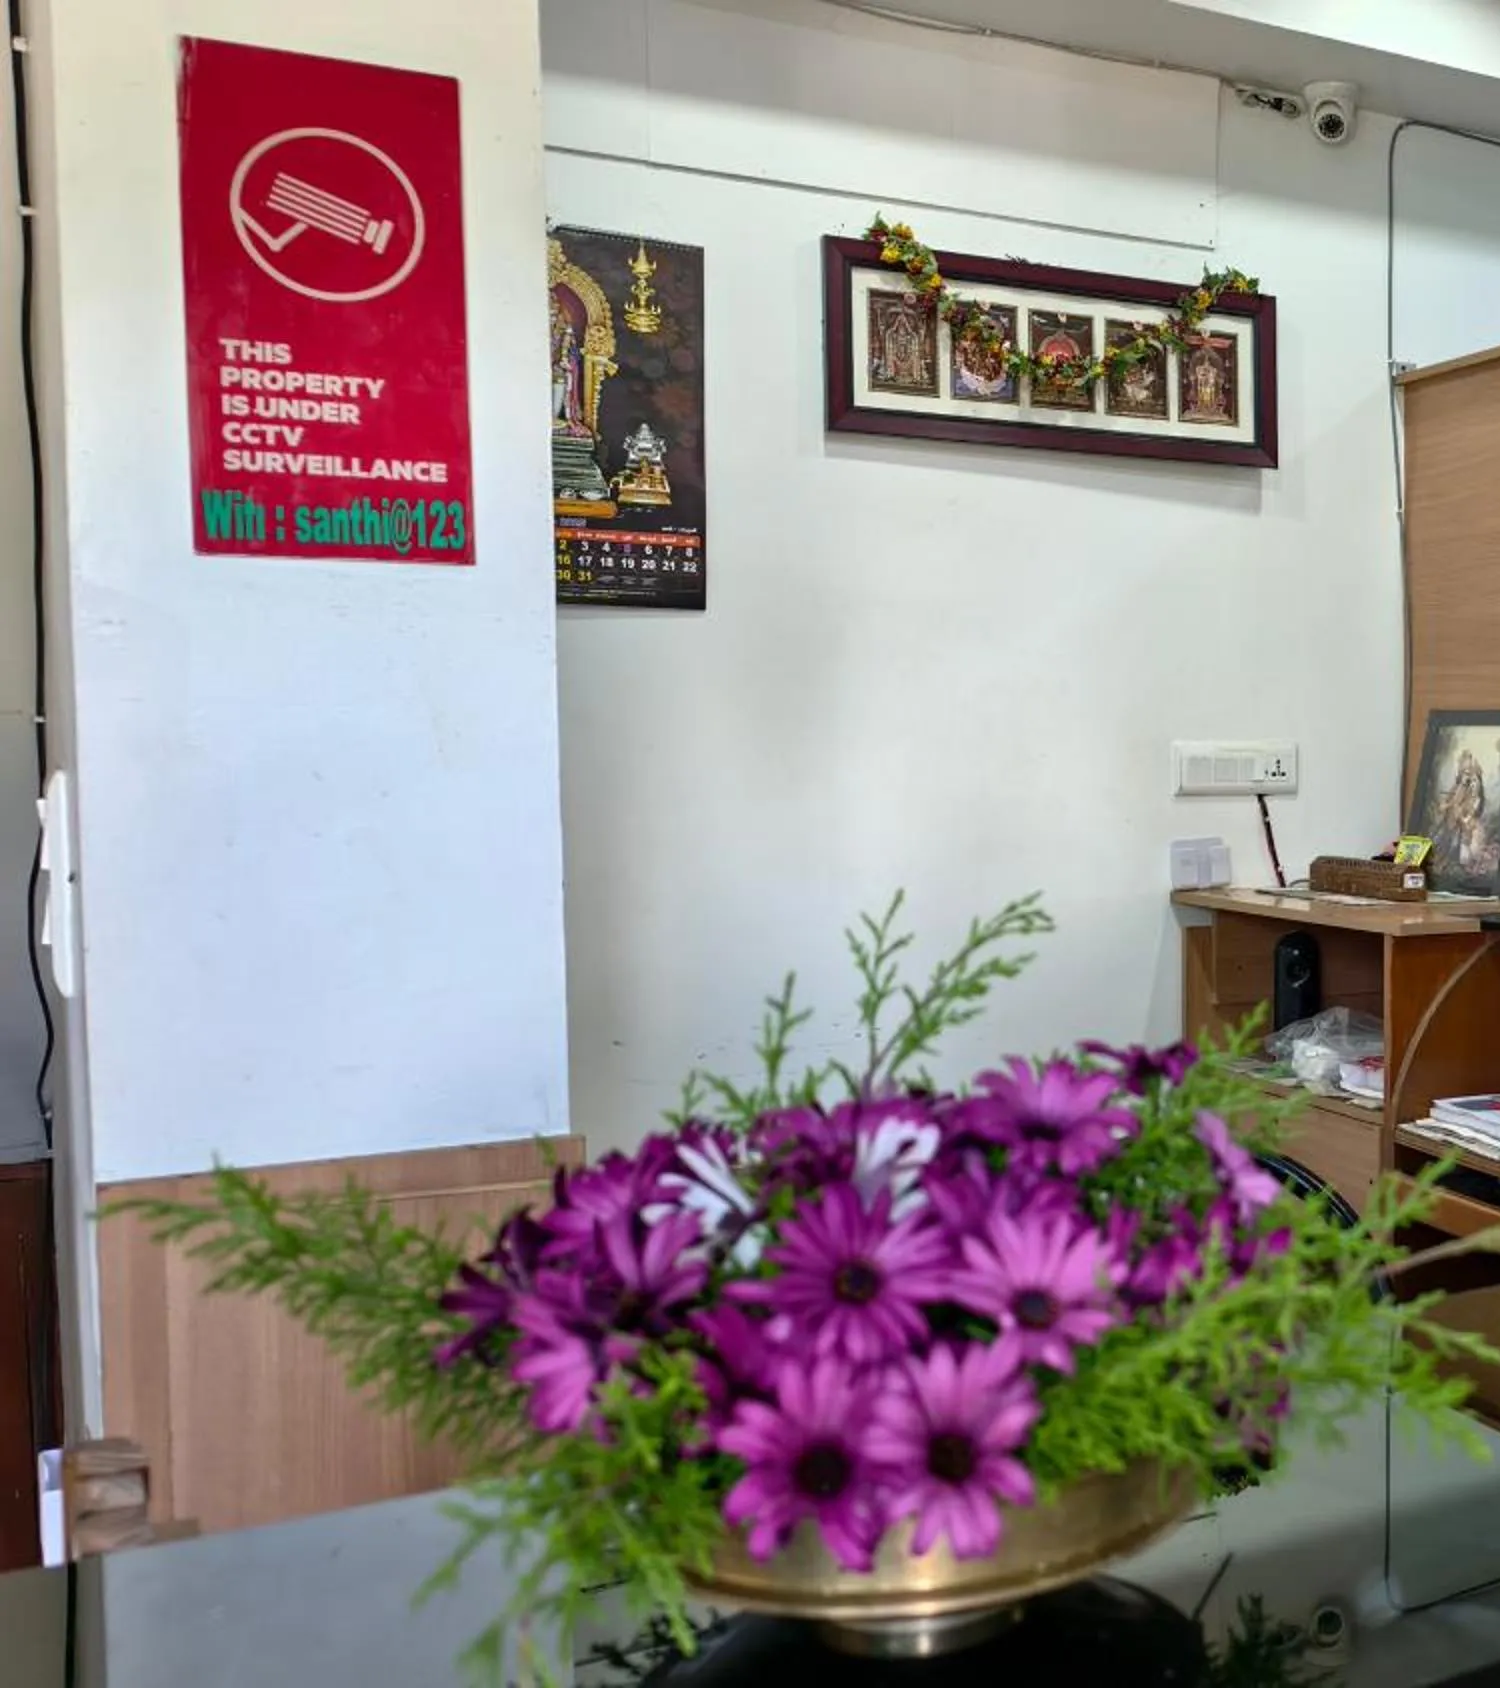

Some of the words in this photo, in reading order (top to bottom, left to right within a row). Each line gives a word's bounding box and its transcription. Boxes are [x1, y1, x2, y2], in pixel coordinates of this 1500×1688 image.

[219, 338, 292, 366] THIS
[220, 366, 385, 400] PROPERTY
[222, 394, 251, 417] IS
[254, 396, 360, 426] UNDER
[222, 421, 304, 447] CCTV
[222, 449, 449, 484] SURVEILLANCE
[295, 496, 466, 555] santhi@123
